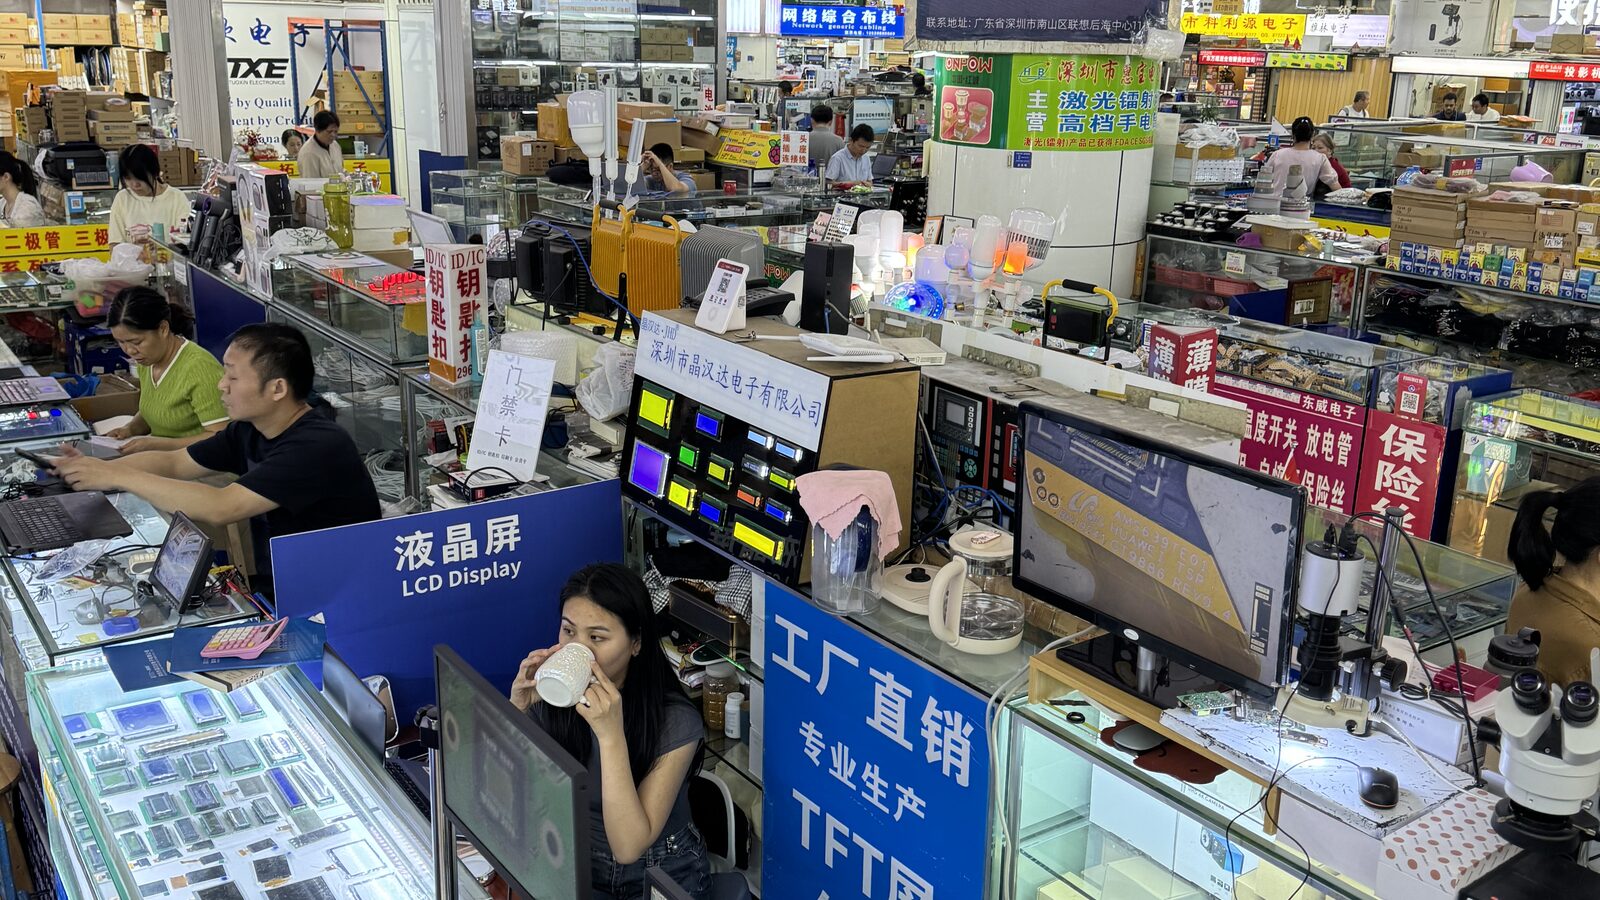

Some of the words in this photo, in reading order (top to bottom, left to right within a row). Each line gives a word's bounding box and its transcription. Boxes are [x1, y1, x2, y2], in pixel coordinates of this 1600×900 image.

[782, 7, 897, 25] 网络综合布线
[945, 55, 993, 73] ONPOW
[236, 97, 251, 109] by
[254, 97, 292, 109] Qualit
[258, 115, 272, 127] by
[4, 231, 61, 251] 二极管
[425, 248, 447, 269] ID/IC
[451, 249, 485, 270] ID/IC
[429, 266, 448, 361] 钥匙扣
[1153, 336, 1176, 382] 薄
[650, 339, 822, 428] 深圳市晶汉达电子有限公司
[495, 364, 523, 447] 门禁卡
[1302, 395, 1357, 420] 东威电子
[1304, 423, 1353, 468] 放电管
[394, 514, 522, 572] 液晶屏
[402, 574, 443, 597] LCD
[449, 561, 522, 588] Display
[772, 614, 974, 788] 工厂直销
[799, 720, 927, 822] 专业生产
